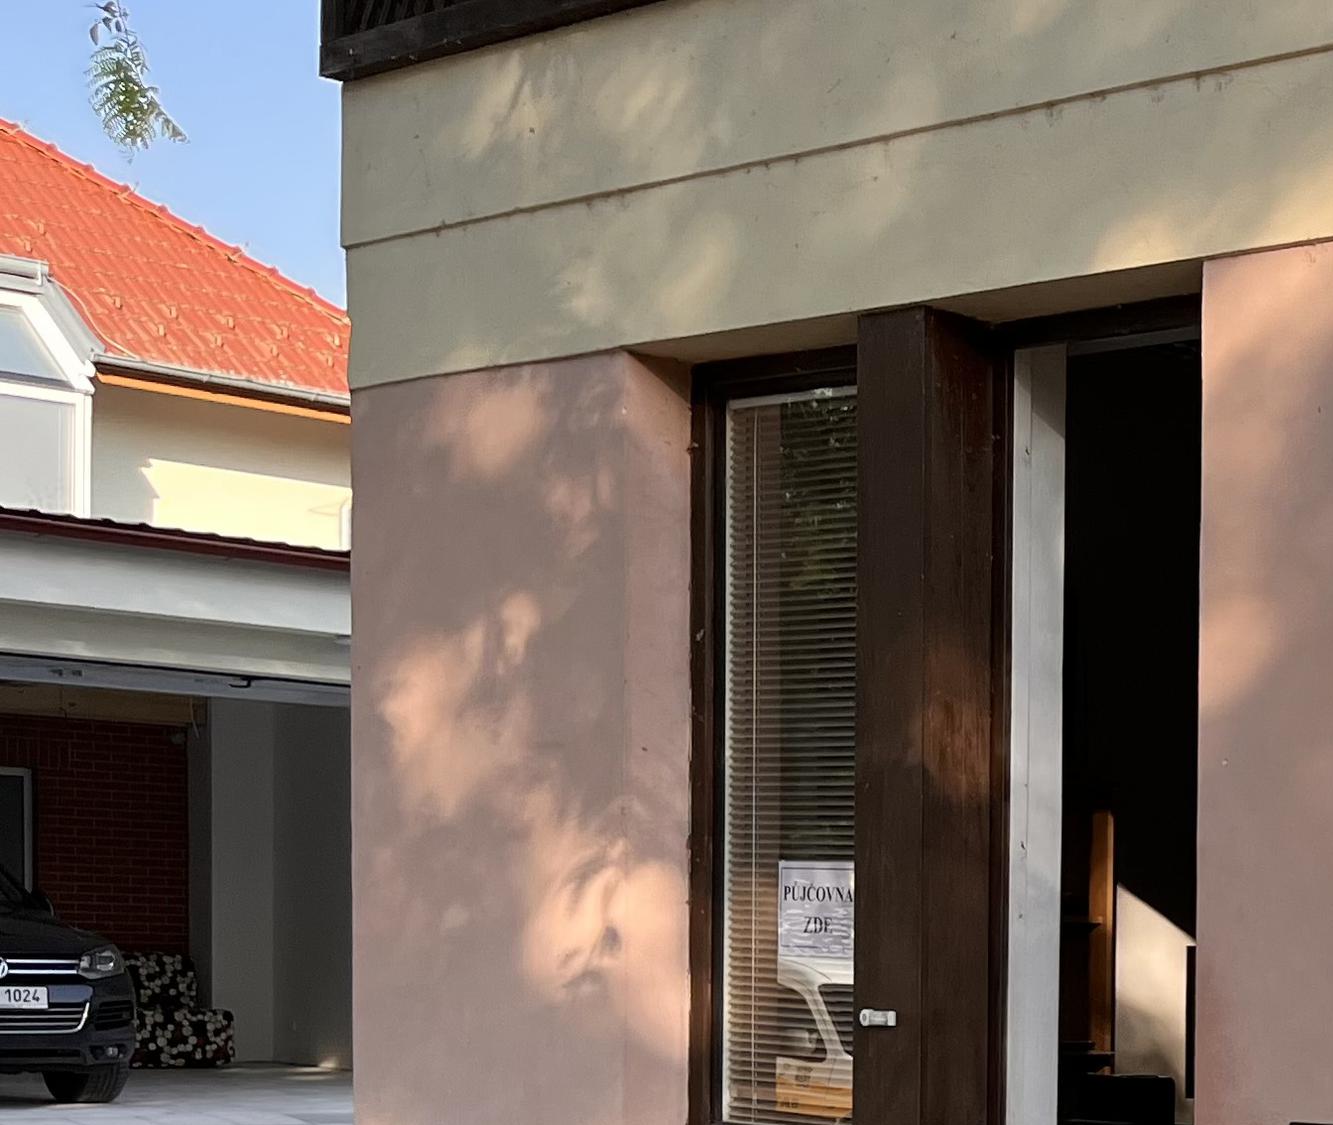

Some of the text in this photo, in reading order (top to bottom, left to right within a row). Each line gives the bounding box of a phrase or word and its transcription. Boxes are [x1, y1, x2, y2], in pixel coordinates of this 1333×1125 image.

[783, 880, 853, 902] PŮJČOVNA
[803, 917, 834, 934] ZDE
[4, 988, 41, 1003] 1024
